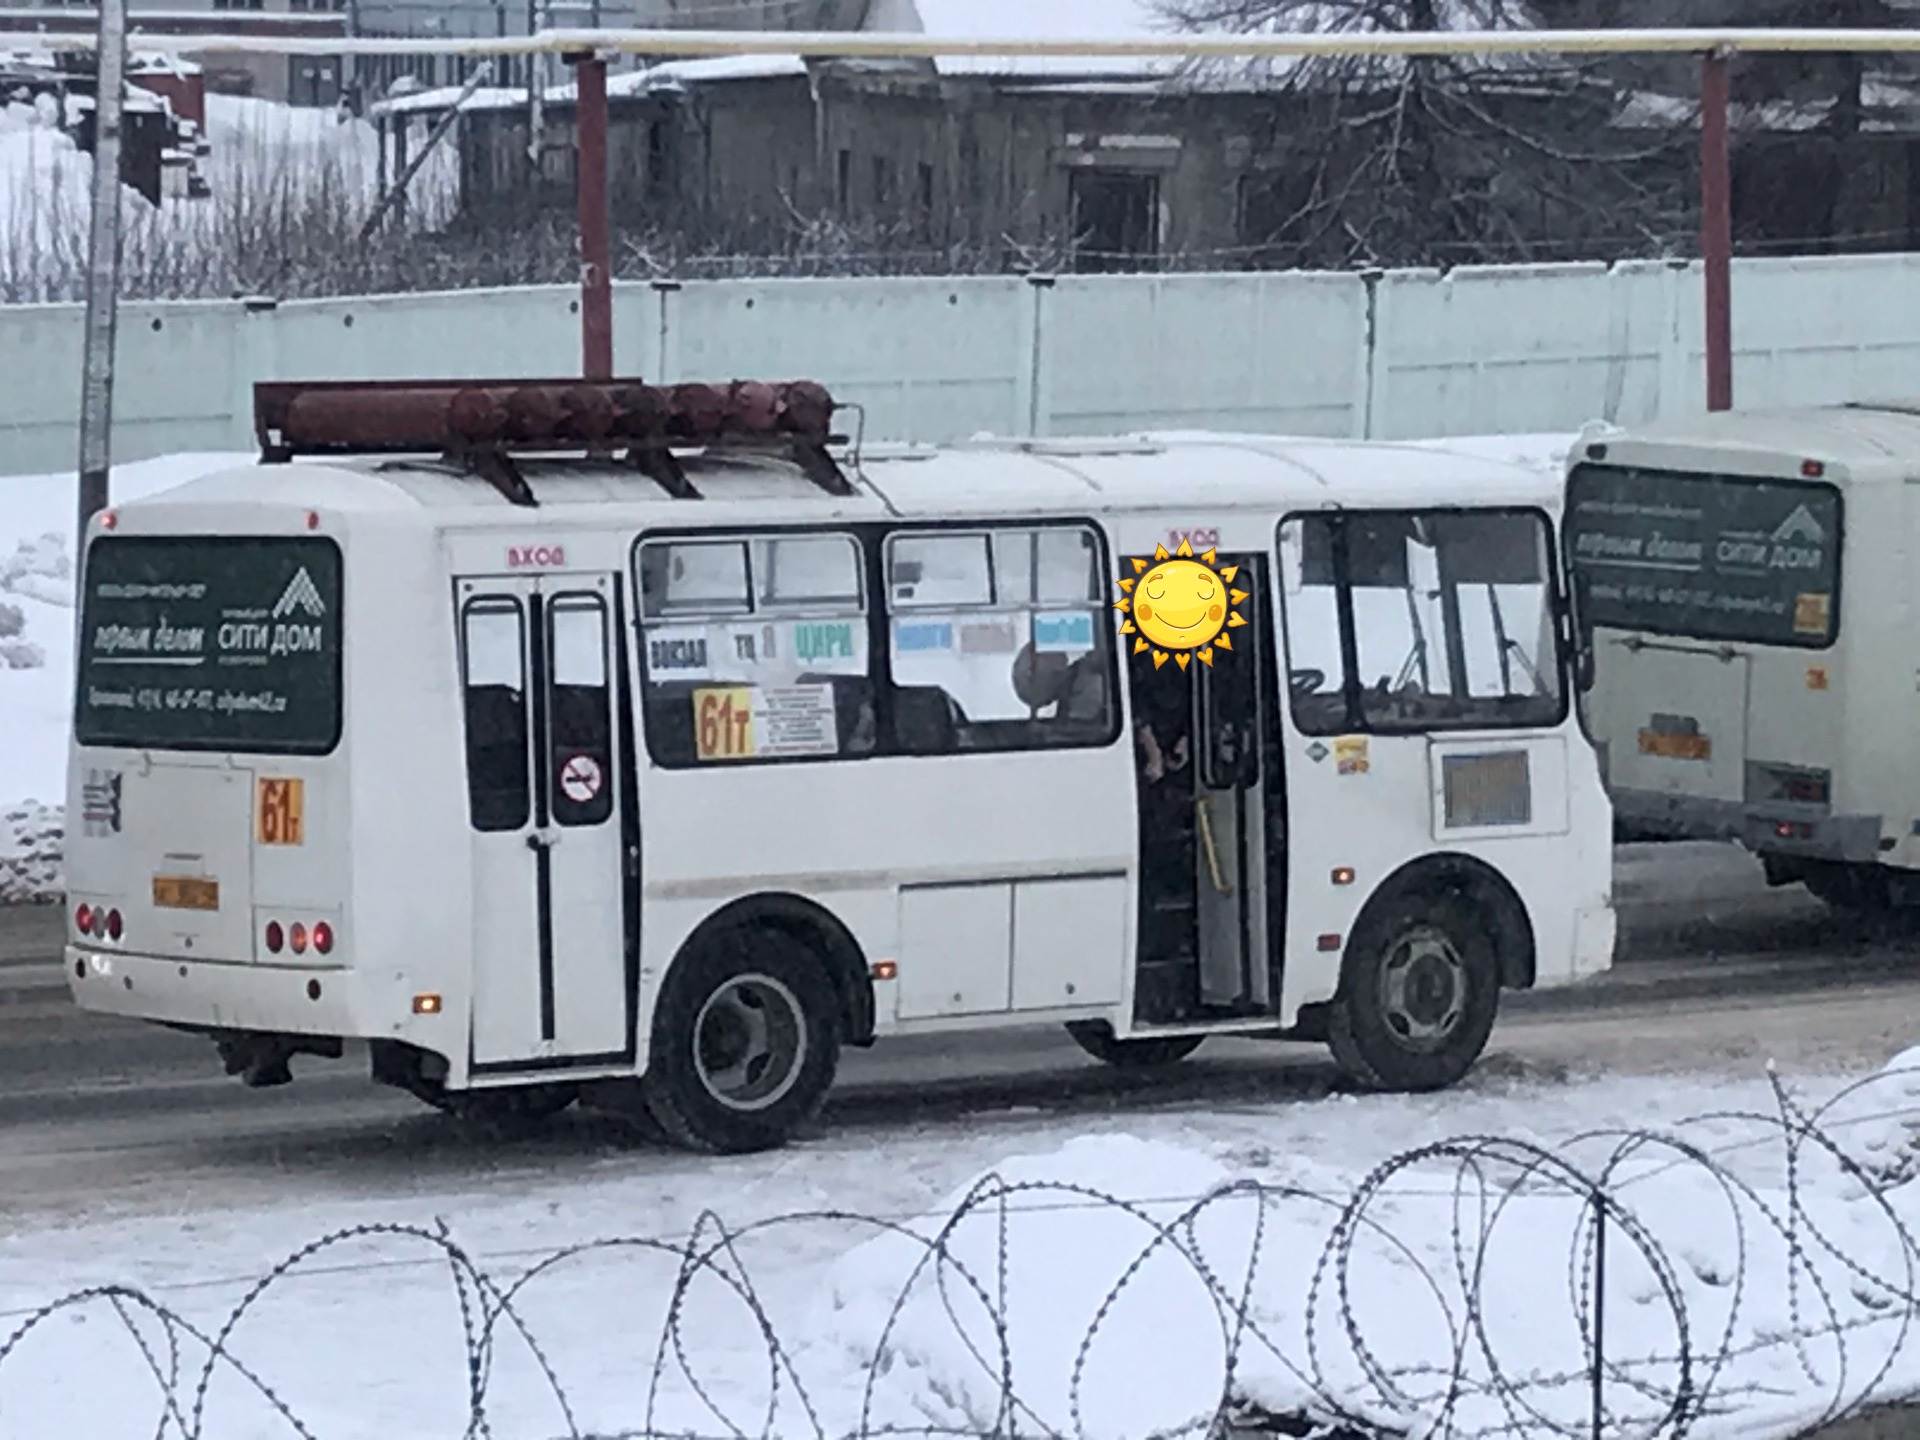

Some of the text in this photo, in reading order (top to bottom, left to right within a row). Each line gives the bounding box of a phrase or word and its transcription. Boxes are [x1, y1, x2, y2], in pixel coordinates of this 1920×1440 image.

[507, 546, 565, 568] ВХОД
[218, 623, 323, 657] СИТИ ДОМ
